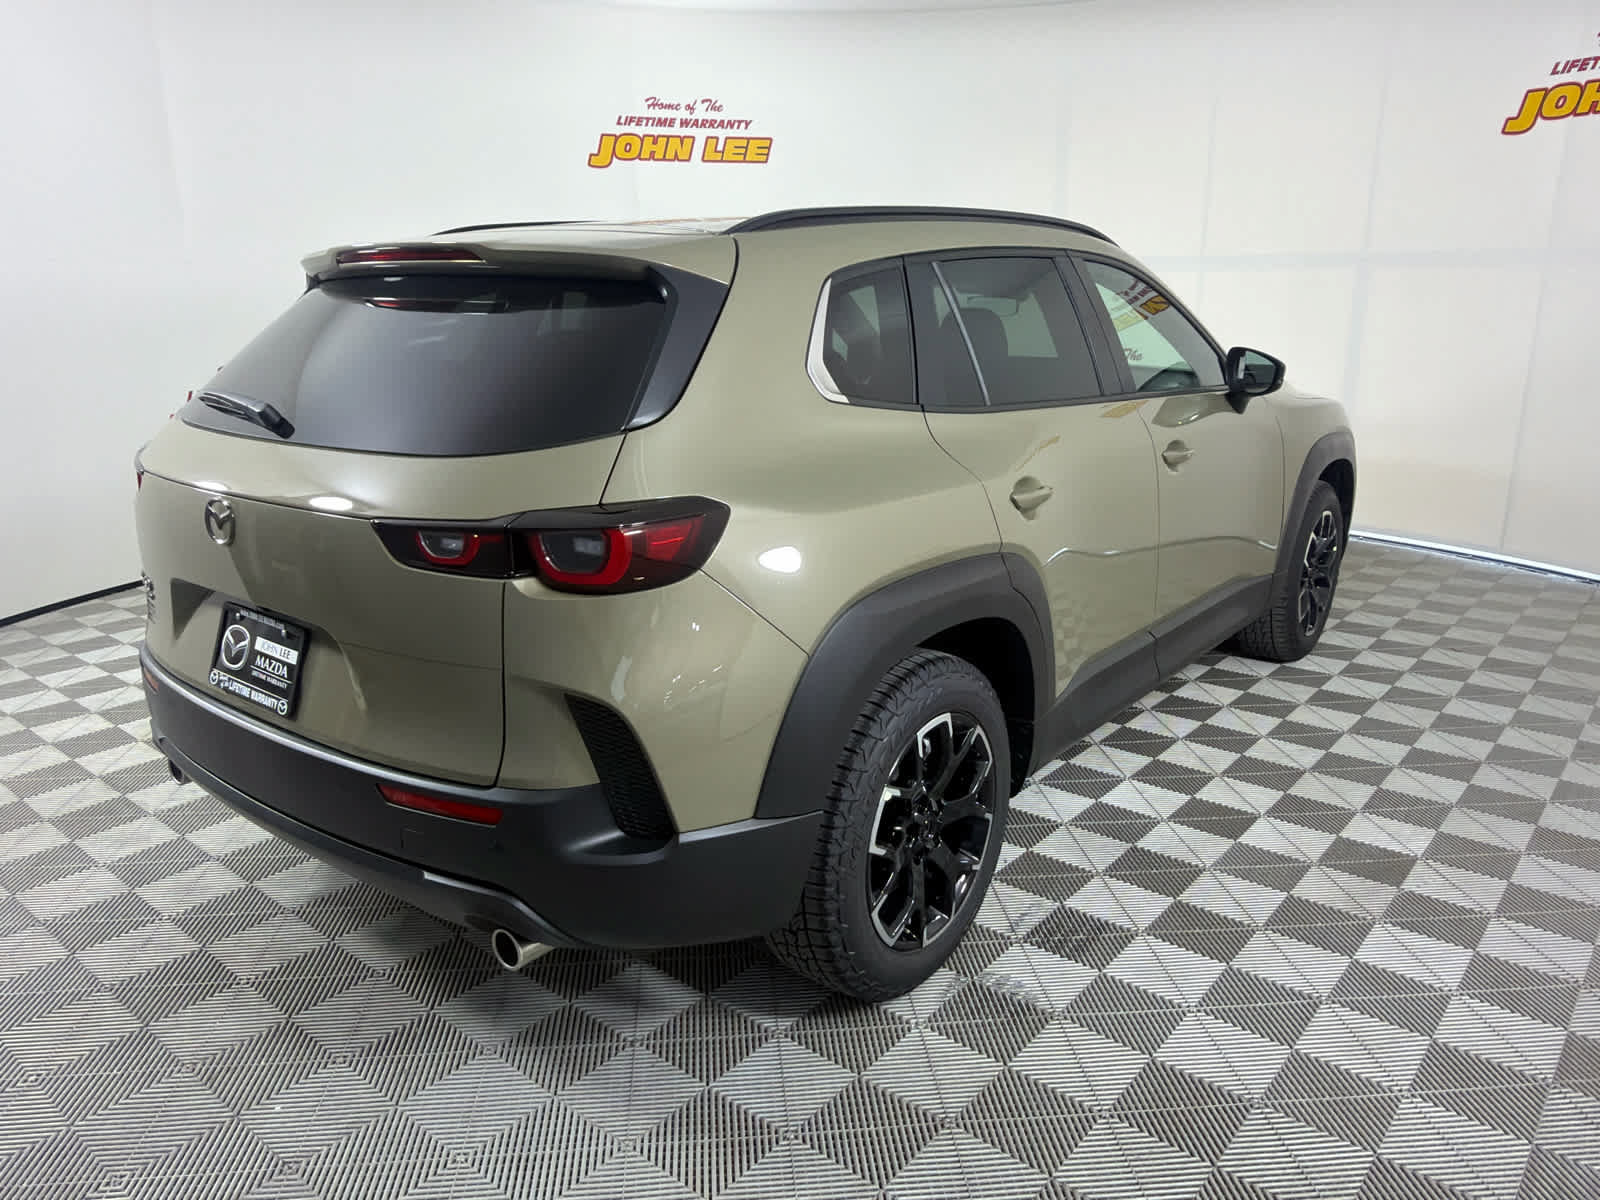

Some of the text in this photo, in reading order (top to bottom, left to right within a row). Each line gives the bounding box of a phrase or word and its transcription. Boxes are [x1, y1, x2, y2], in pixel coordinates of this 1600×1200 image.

[1550, 56, 1600, 75] LIFET
[644, 97, 723, 115] Home of The
[616, 115, 752, 130] LIFETIME WARRANTY
[588, 133, 773, 168] JOHN LEE
[279, 647, 291, 659] LEE
[255, 654, 288, 679] MAZDA
[228, 679, 251, 698] LIFETIME
[251, 689, 278, 710] WARRANTY
